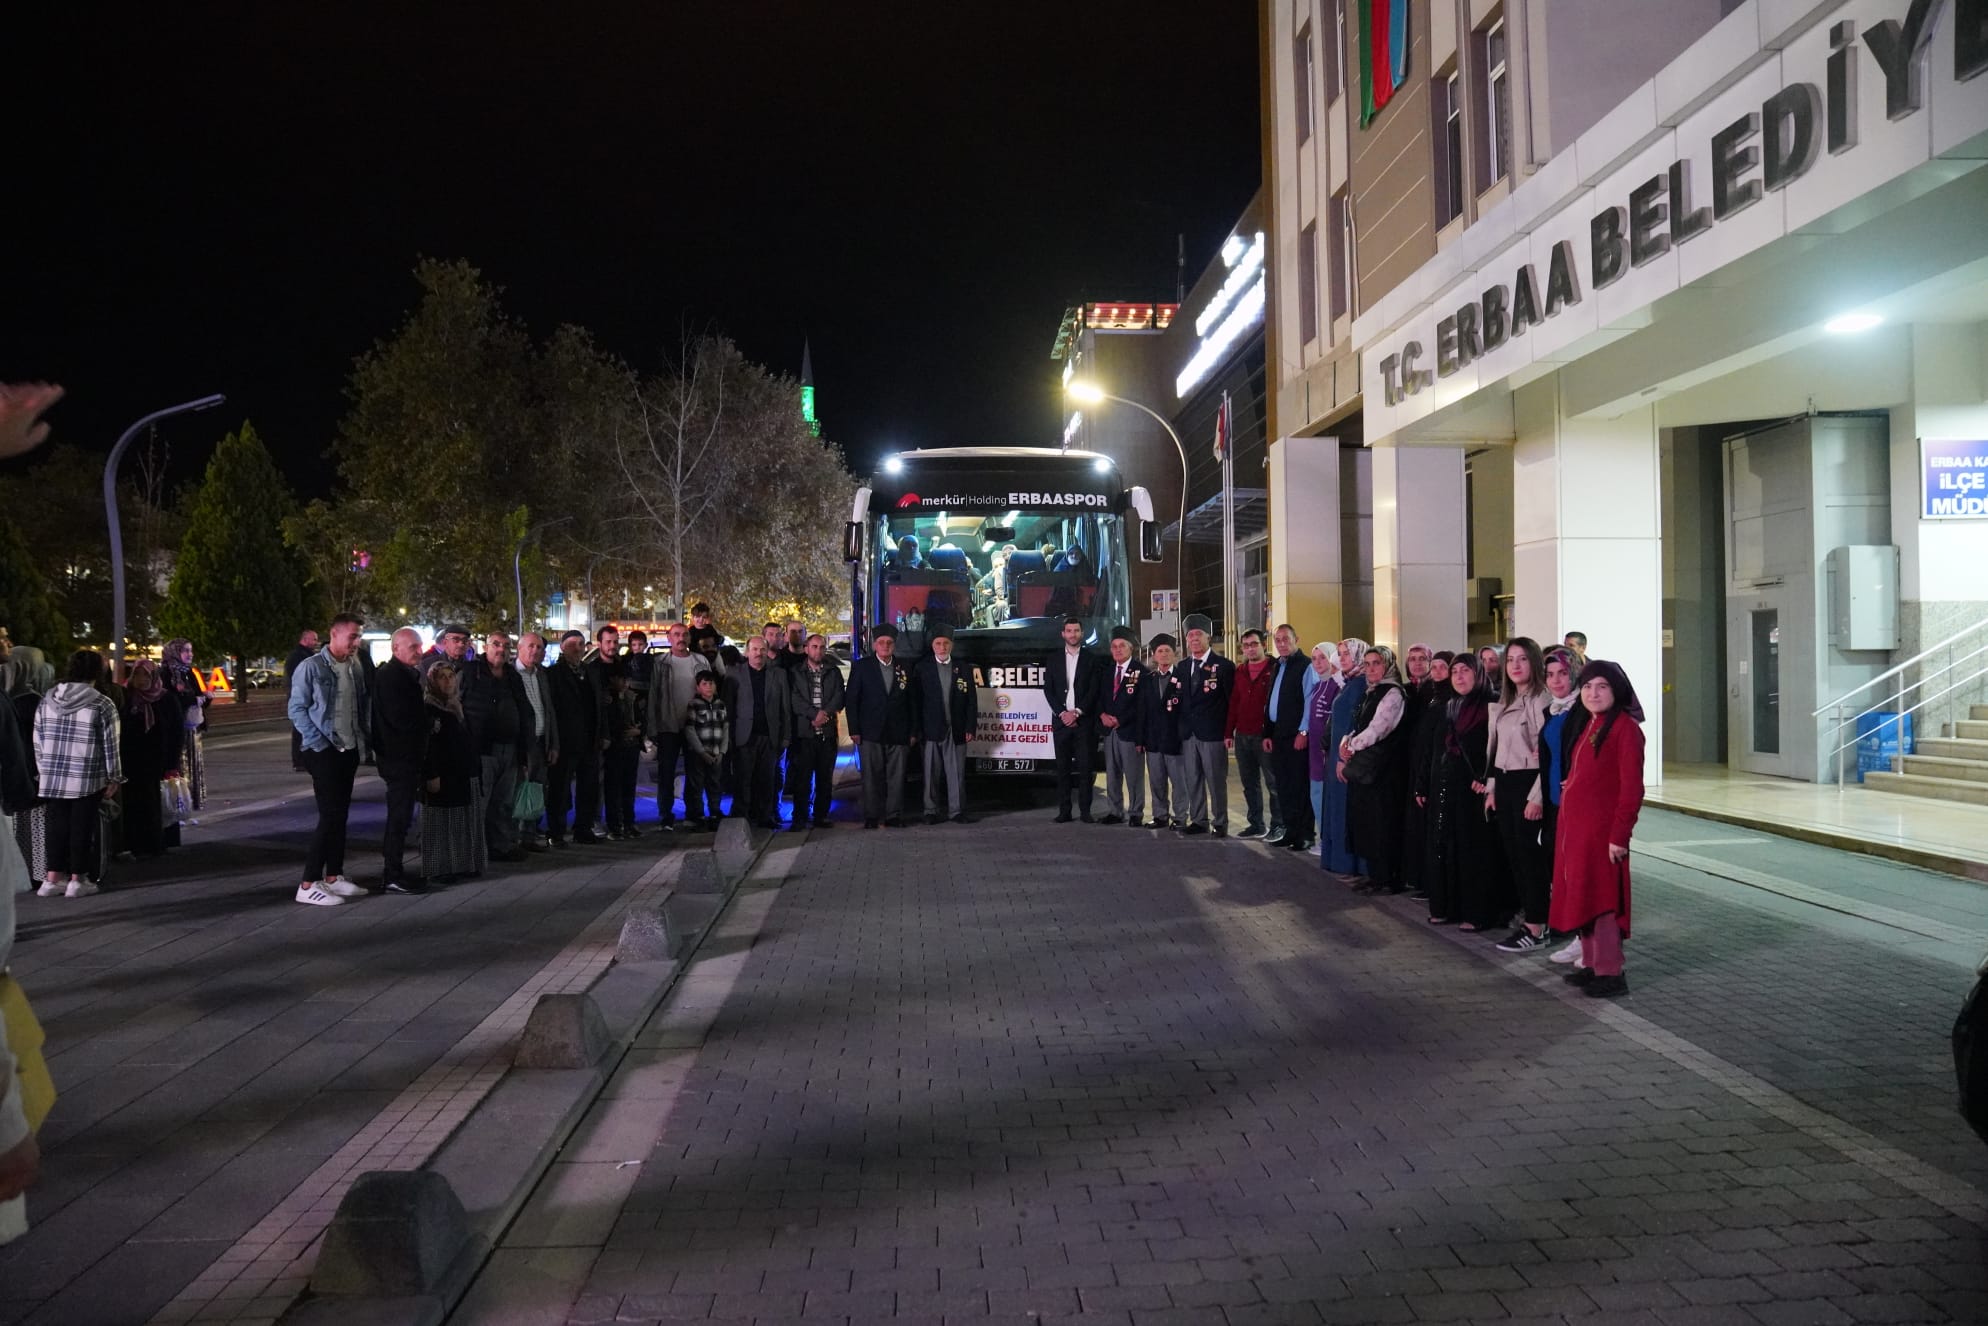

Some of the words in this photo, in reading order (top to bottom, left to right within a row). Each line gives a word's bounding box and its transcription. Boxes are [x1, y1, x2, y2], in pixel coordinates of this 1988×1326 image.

[1437, 239, 1582, 377] ERBAA
[1930, 456, 1972, 467] ERBAA
[1939, 472, 1985, 494] İLÇE
[922, 494, 965, 506] merkür
[968, 495, 1007, 506] Holding
[1008, 492, 1107, 507] ERBAASPOR
[1931, 493, 1988, 514] MÜD
[991, 722, 1014, 732] GAZİ
[1018, 734, 1048, 743] GEZİSİ
[998, 760, 1009, 770] KF
[1014, 760, 1030, 770] 577
